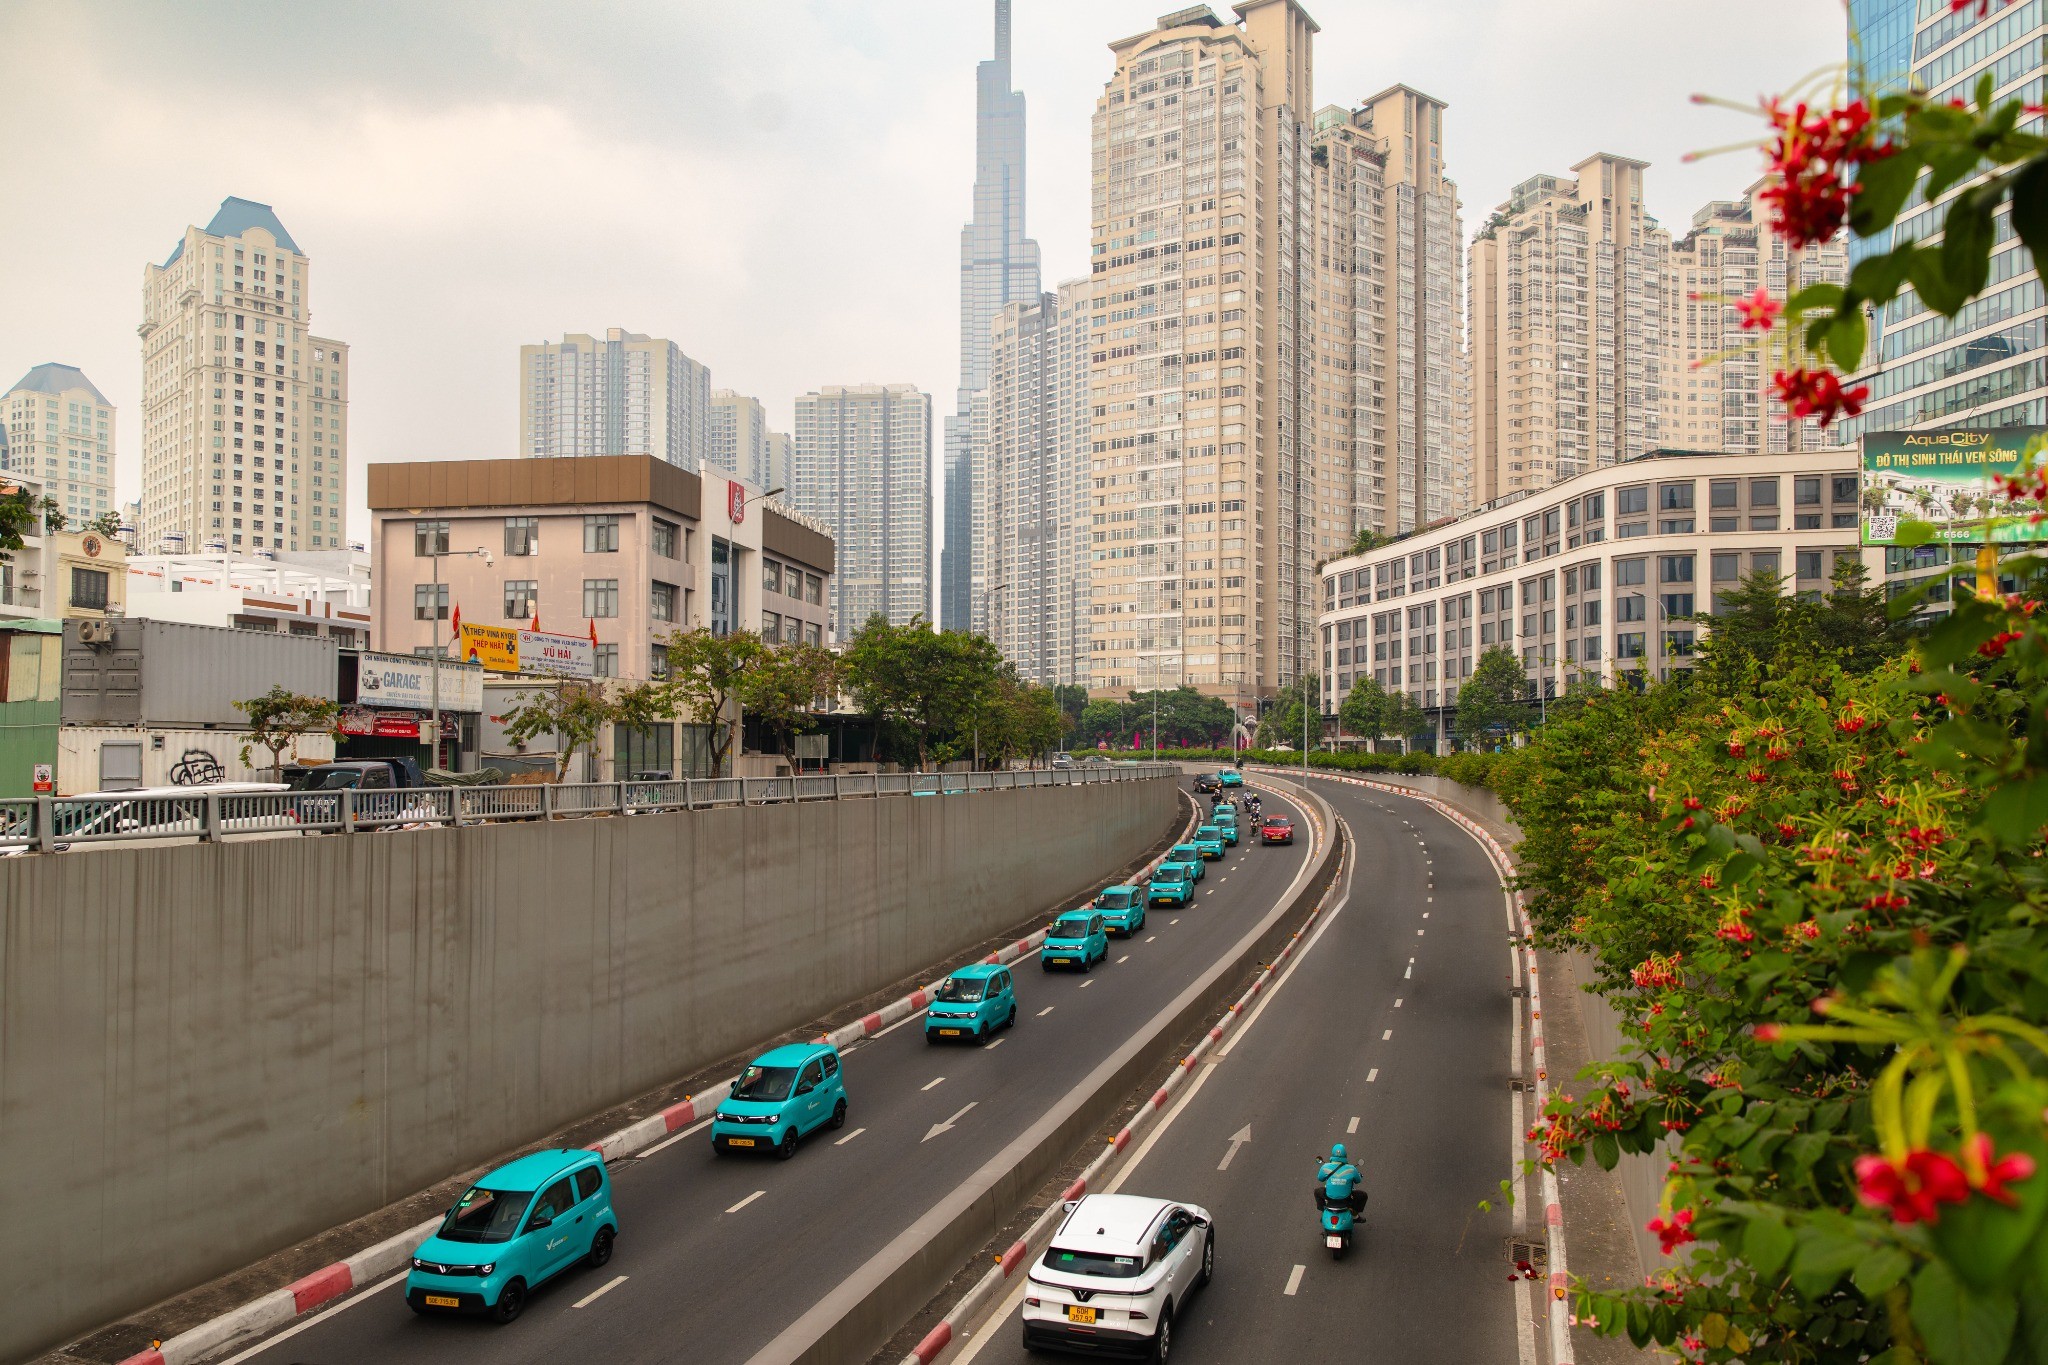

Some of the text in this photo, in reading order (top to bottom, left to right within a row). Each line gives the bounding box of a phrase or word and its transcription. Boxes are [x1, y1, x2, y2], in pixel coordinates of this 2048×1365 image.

[1876, 447, 2018, 468] ĐÔ THỊ SINH THÁI VEN SÔNG
[1943, 530, 1970, 539] 6666
[470, 627, 517, 640] THÉP VINA KYOEI
[473, 638, 504, 651] THÉP NHẬT
[543, 646, 571, 659] VŨ HẢI
[383, 671, 421, 690] GARAGE
[1071, 1314, 1093, 1322] 357.92
